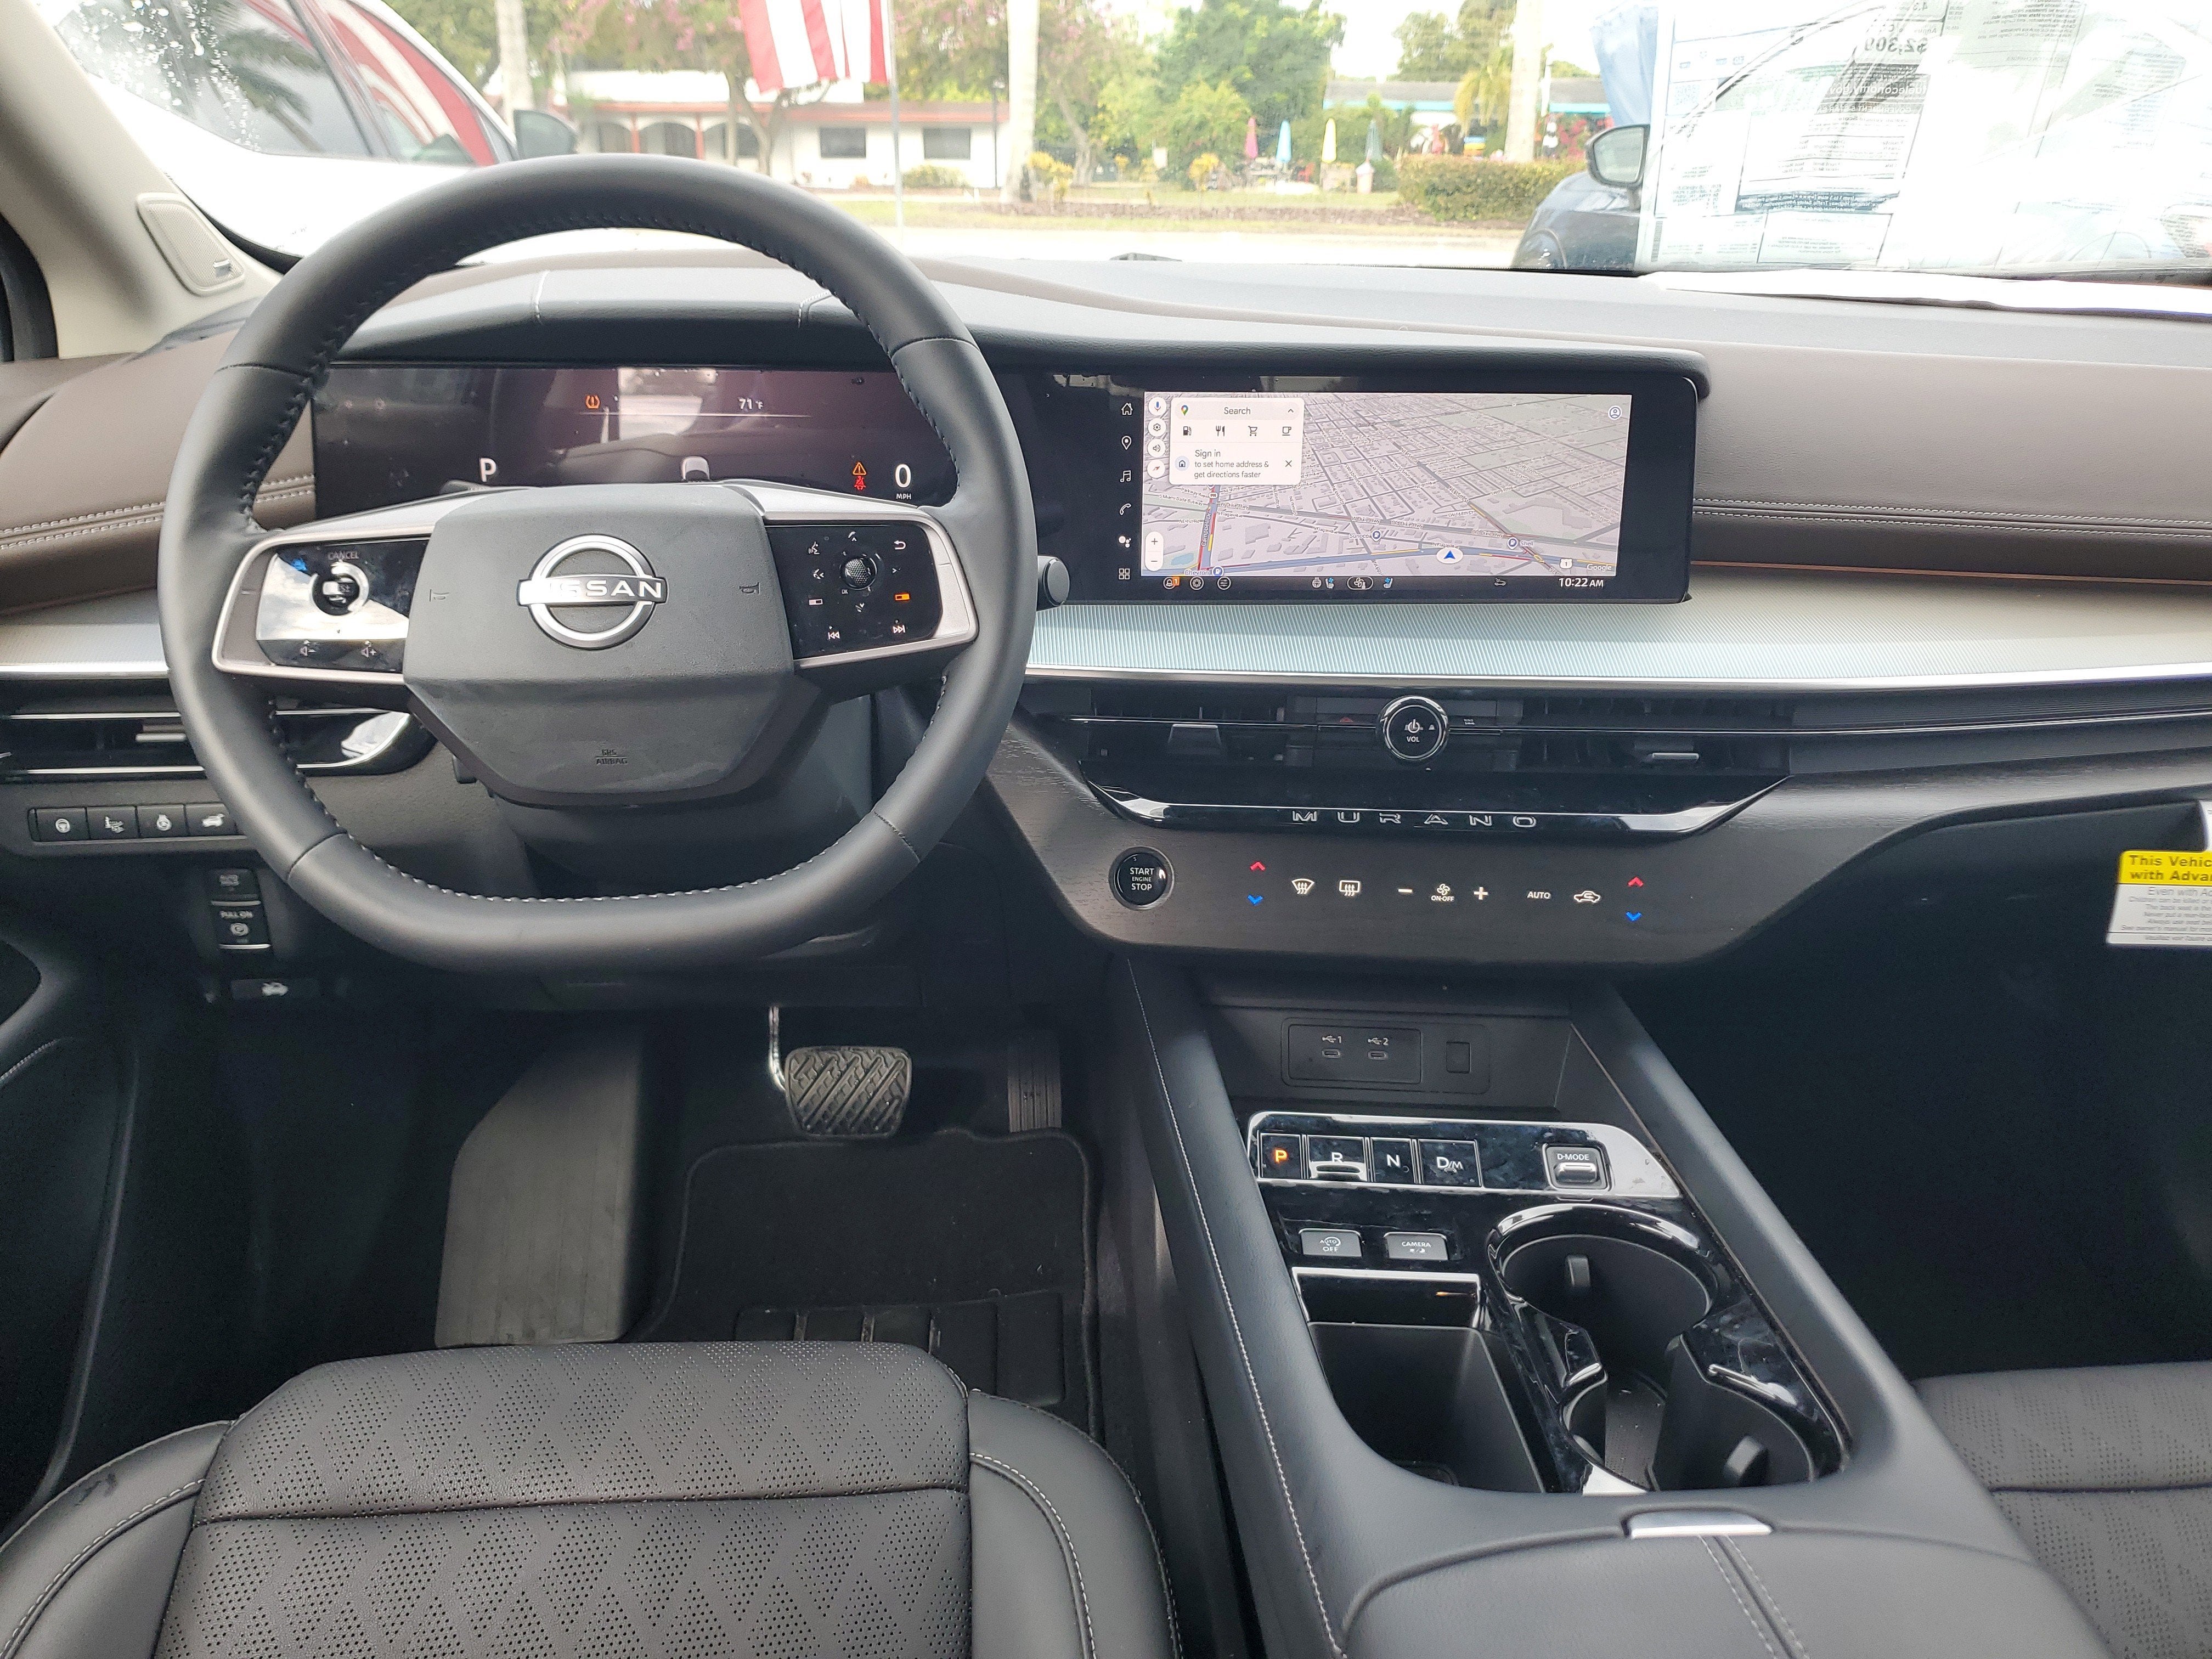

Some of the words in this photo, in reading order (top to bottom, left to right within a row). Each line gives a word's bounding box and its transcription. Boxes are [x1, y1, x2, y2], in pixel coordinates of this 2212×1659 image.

[1223, 407, 1251, 415] Search
[1194, 449, 1212, 459] Sign
[479, 457, 496, 482] P
[895, 463, 911, 488] 0
[1587, 563, 1612, 572] Google
[1559, 577, 1589, 588] 10:22
[1589, 579, 1604, 588] AM
[525, 579, 662, 598] ISSAN
[1291, 810, 1537, 828] MURANO
[2129, 855, 2163, 867] This
[1130, 867, 1155, 876] START
[2130, 870, 2164, 881] with
[1131, 883, 1153, 891] STOP
[2148, 887, 2175, 896] Even
[1527, 890, 1551, 900] AUTO
[1337, 1036, 1342, 1044] 1
[1383, 1037, 1389, 1046] 2
[1275, 1149, 1288, 1163] P
[1331, 1152, 1343, 1164] R
[1386, 1154, 1401, 1168] N
